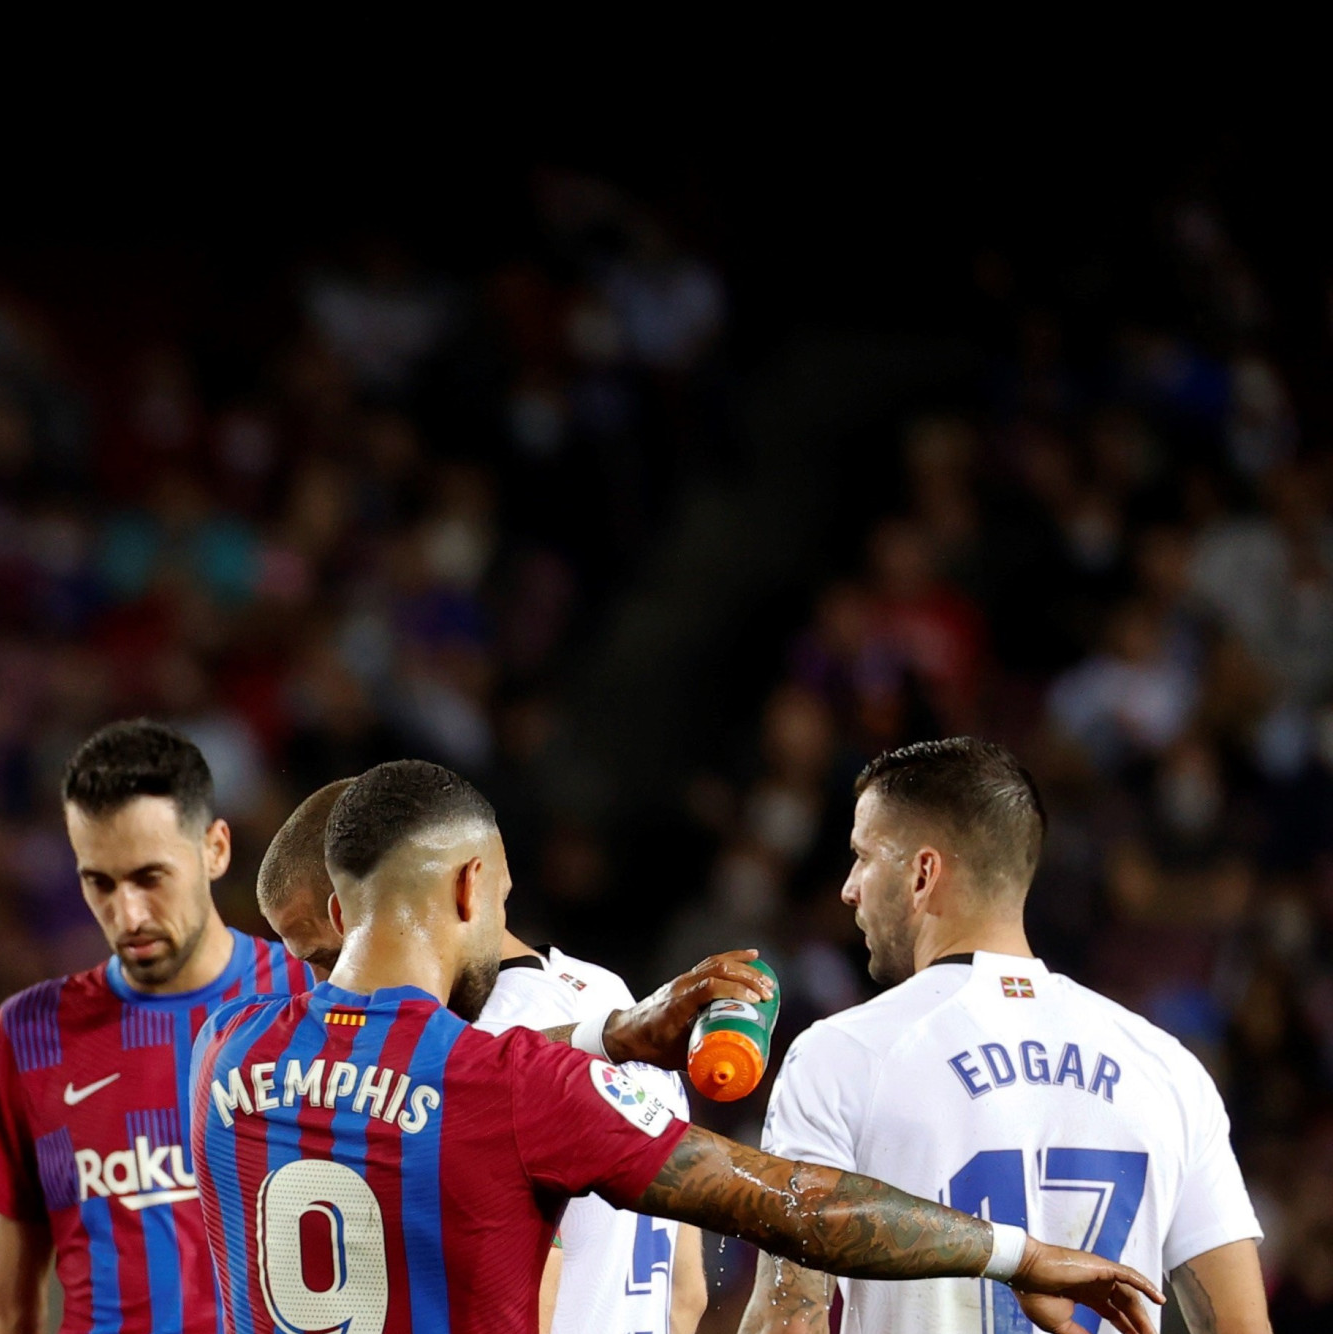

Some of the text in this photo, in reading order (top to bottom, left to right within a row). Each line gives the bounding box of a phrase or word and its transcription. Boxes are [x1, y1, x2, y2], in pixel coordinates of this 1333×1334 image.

[211, 1060, 441, 1134] MEMPHIS
[948, 1040, 1122, 1104] EDGAR
[75, 1136, 196, 1202] Raku
